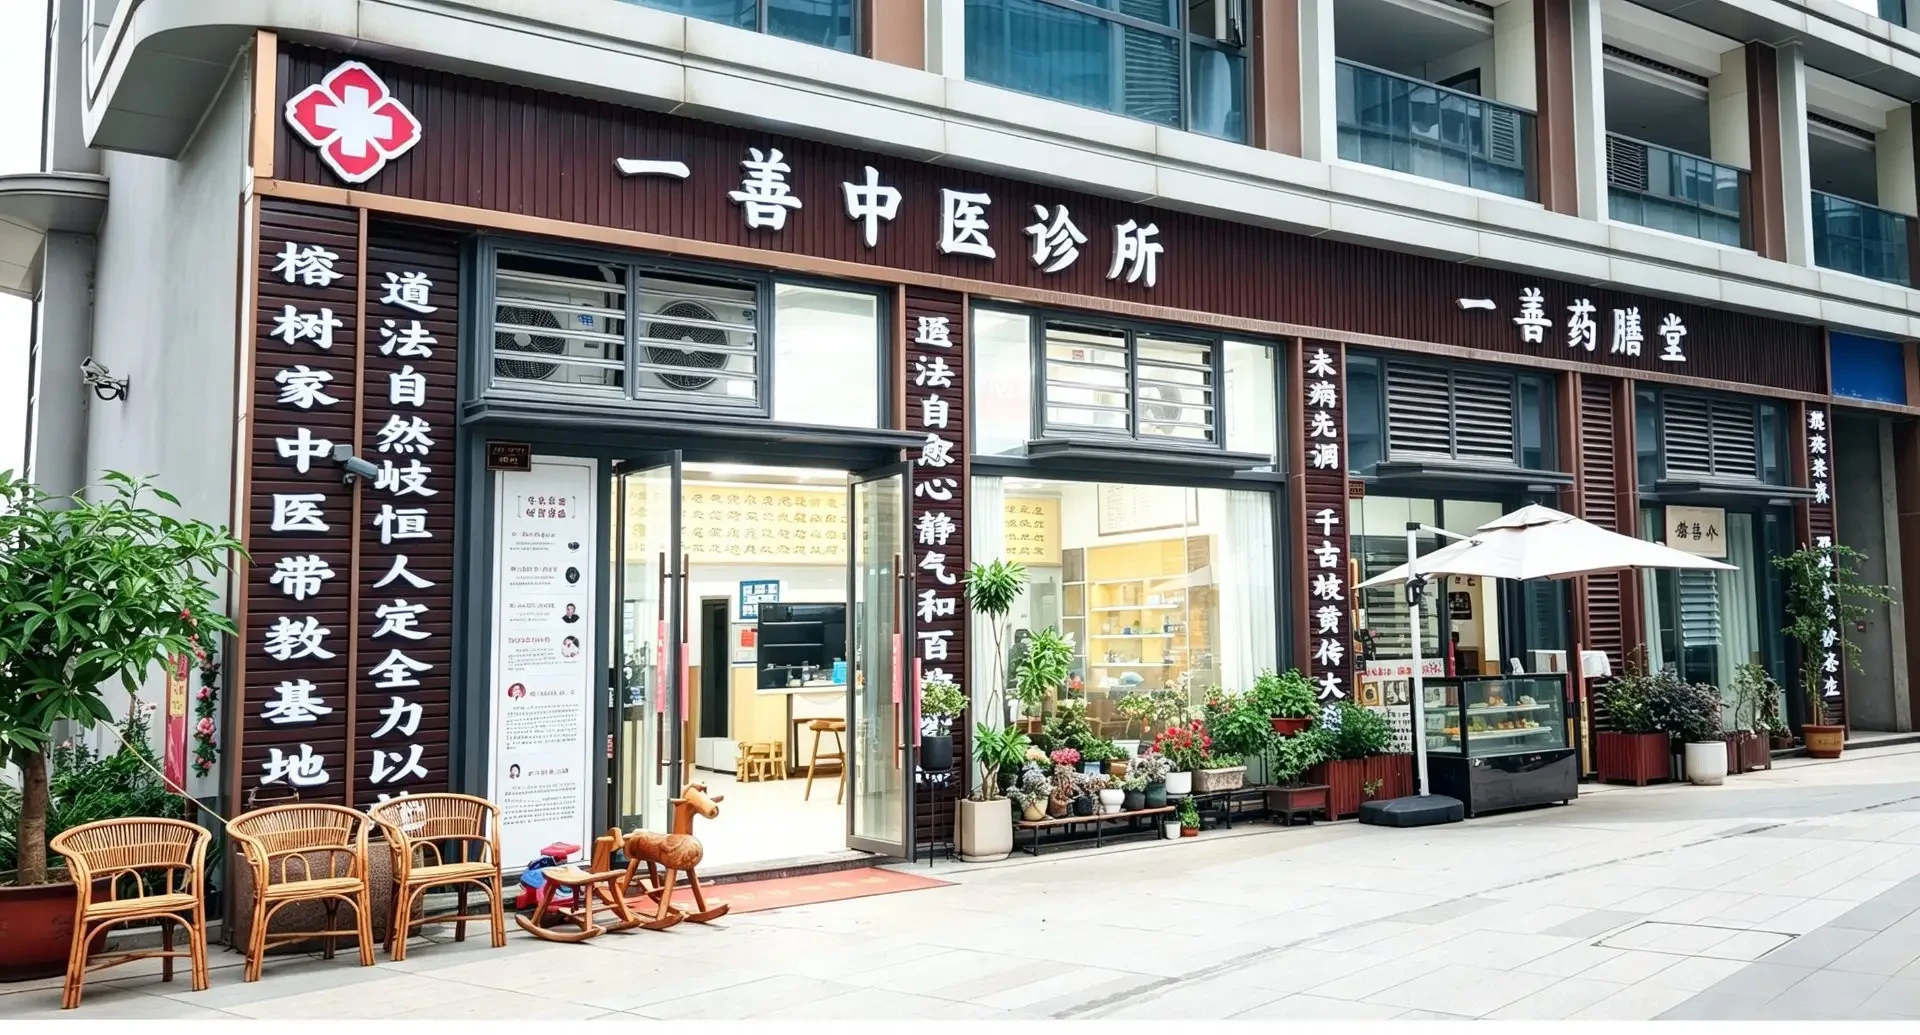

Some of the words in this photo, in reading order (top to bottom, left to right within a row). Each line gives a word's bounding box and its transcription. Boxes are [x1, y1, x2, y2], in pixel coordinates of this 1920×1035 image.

[613, 147, 1165, 288] 一善中医诊所
[1456, 287, 1688, 362] 一善药膳堂
[260, 241, 344, 788] 榕树家中医带教基地
